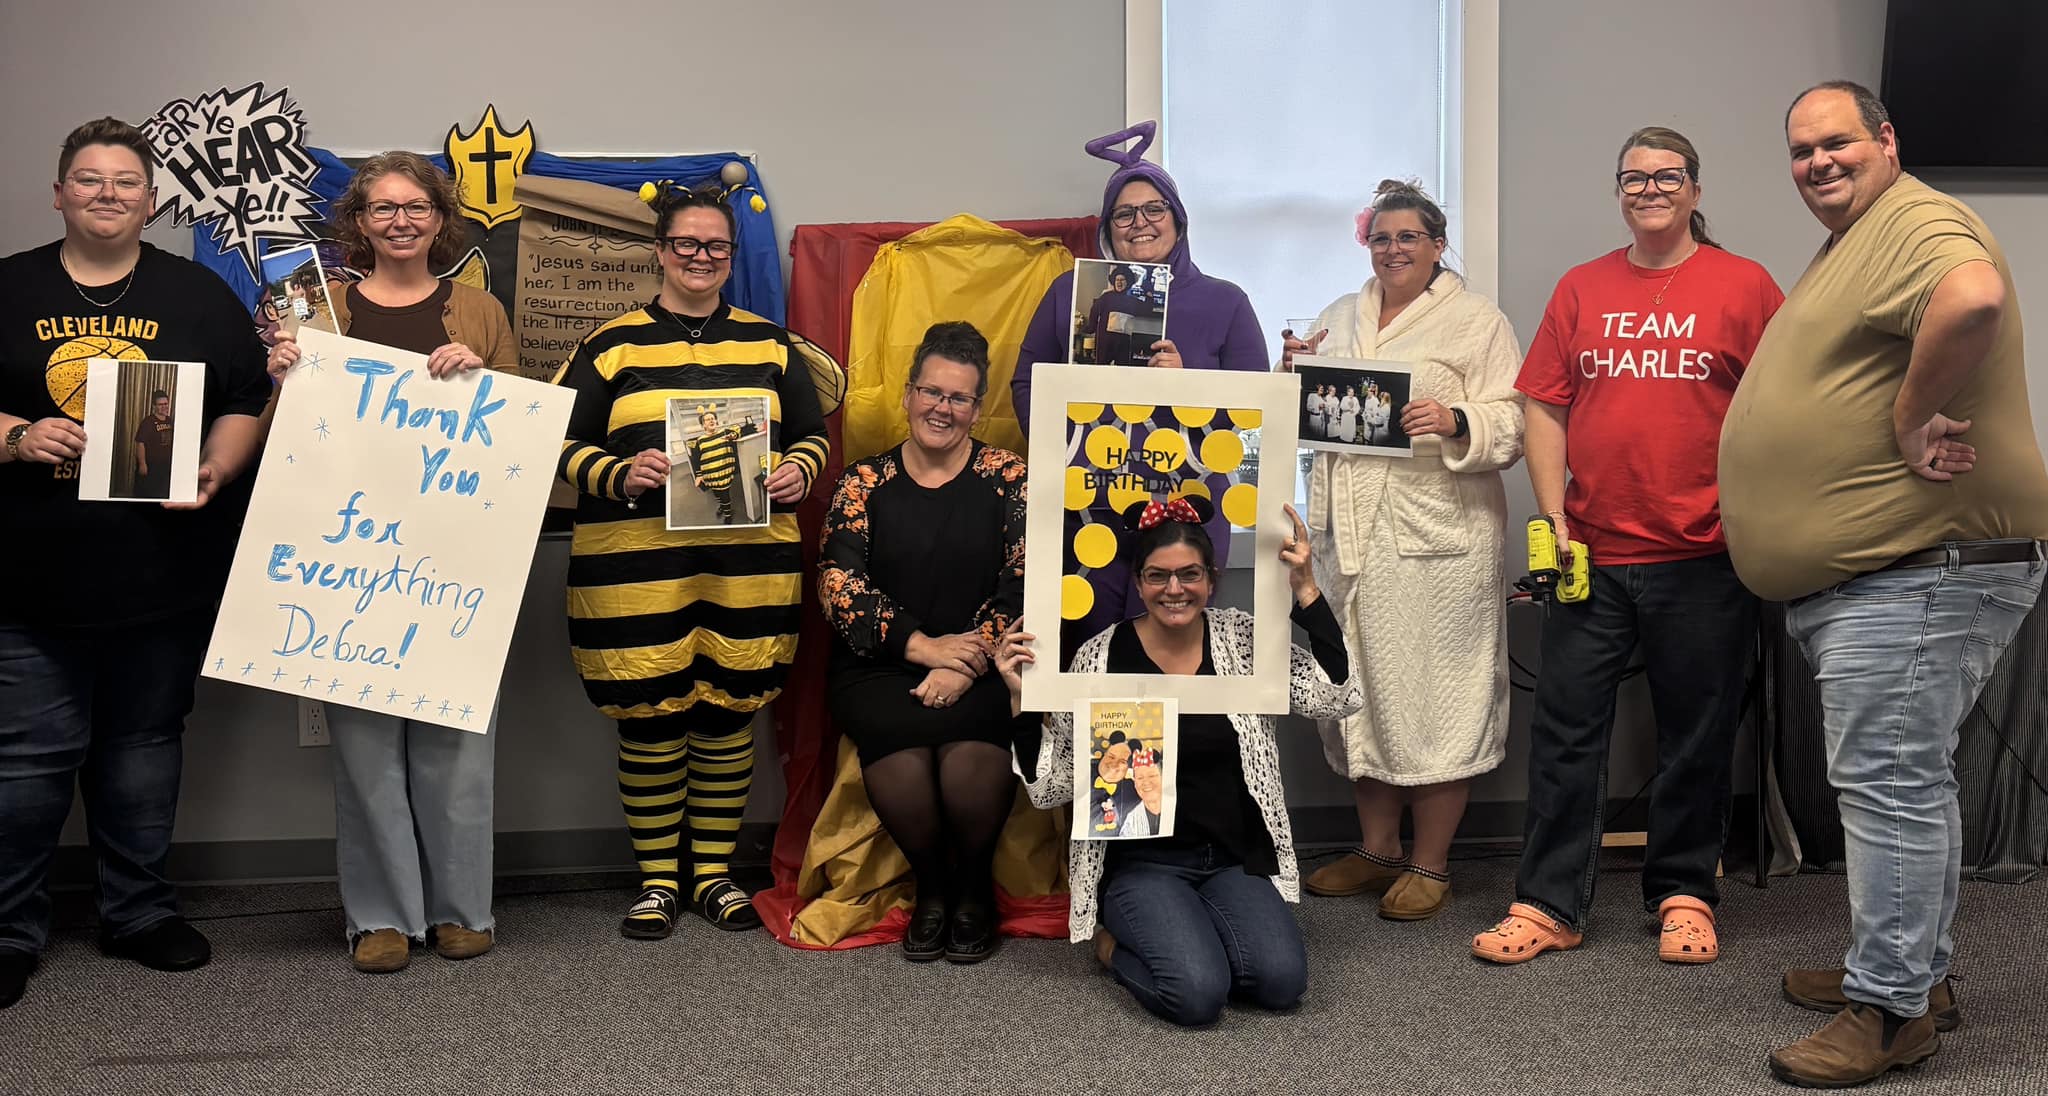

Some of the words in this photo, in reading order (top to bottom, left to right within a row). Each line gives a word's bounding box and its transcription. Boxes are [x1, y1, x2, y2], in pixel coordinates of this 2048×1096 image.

[201, 105, 234, 134] Ye
[166, 115, 309, 202] HEAR
[214, 183, 290, 238] Ye!!
[591, 260, 625, 273] said
[631, 262, 657, 275] unt
[562, 275, 571, 290] I
[577, 278, 602, 291] am
[608, 277, 635, 291] the
[524, 295, 627, 313] resurrection,
[35, 315, 159, 341] CLEVELAND
[522, 314, 549, 329] the
[1601, 312, 1696, 339] TEAM
[520, 332, 579, 351] believe
[519, 352, 537, 368] he
[1580, 348, 1714, 380] CHARLES
[344, 357, 507, 447] Thank
[420, 444, 480, 496] You
[1106, 447, 1178, 469] HAPPY
[1084, 472, 1185, 493] BIRTHDAY
[321, 491, 404, 545] for
[267, 544, 485, 638] Everything
[272, 603, 419, 670] Debra!
[1094, 721, 1134, 729] BIRTHDAY
[1100, 712, 1128, 720] HAPPY
